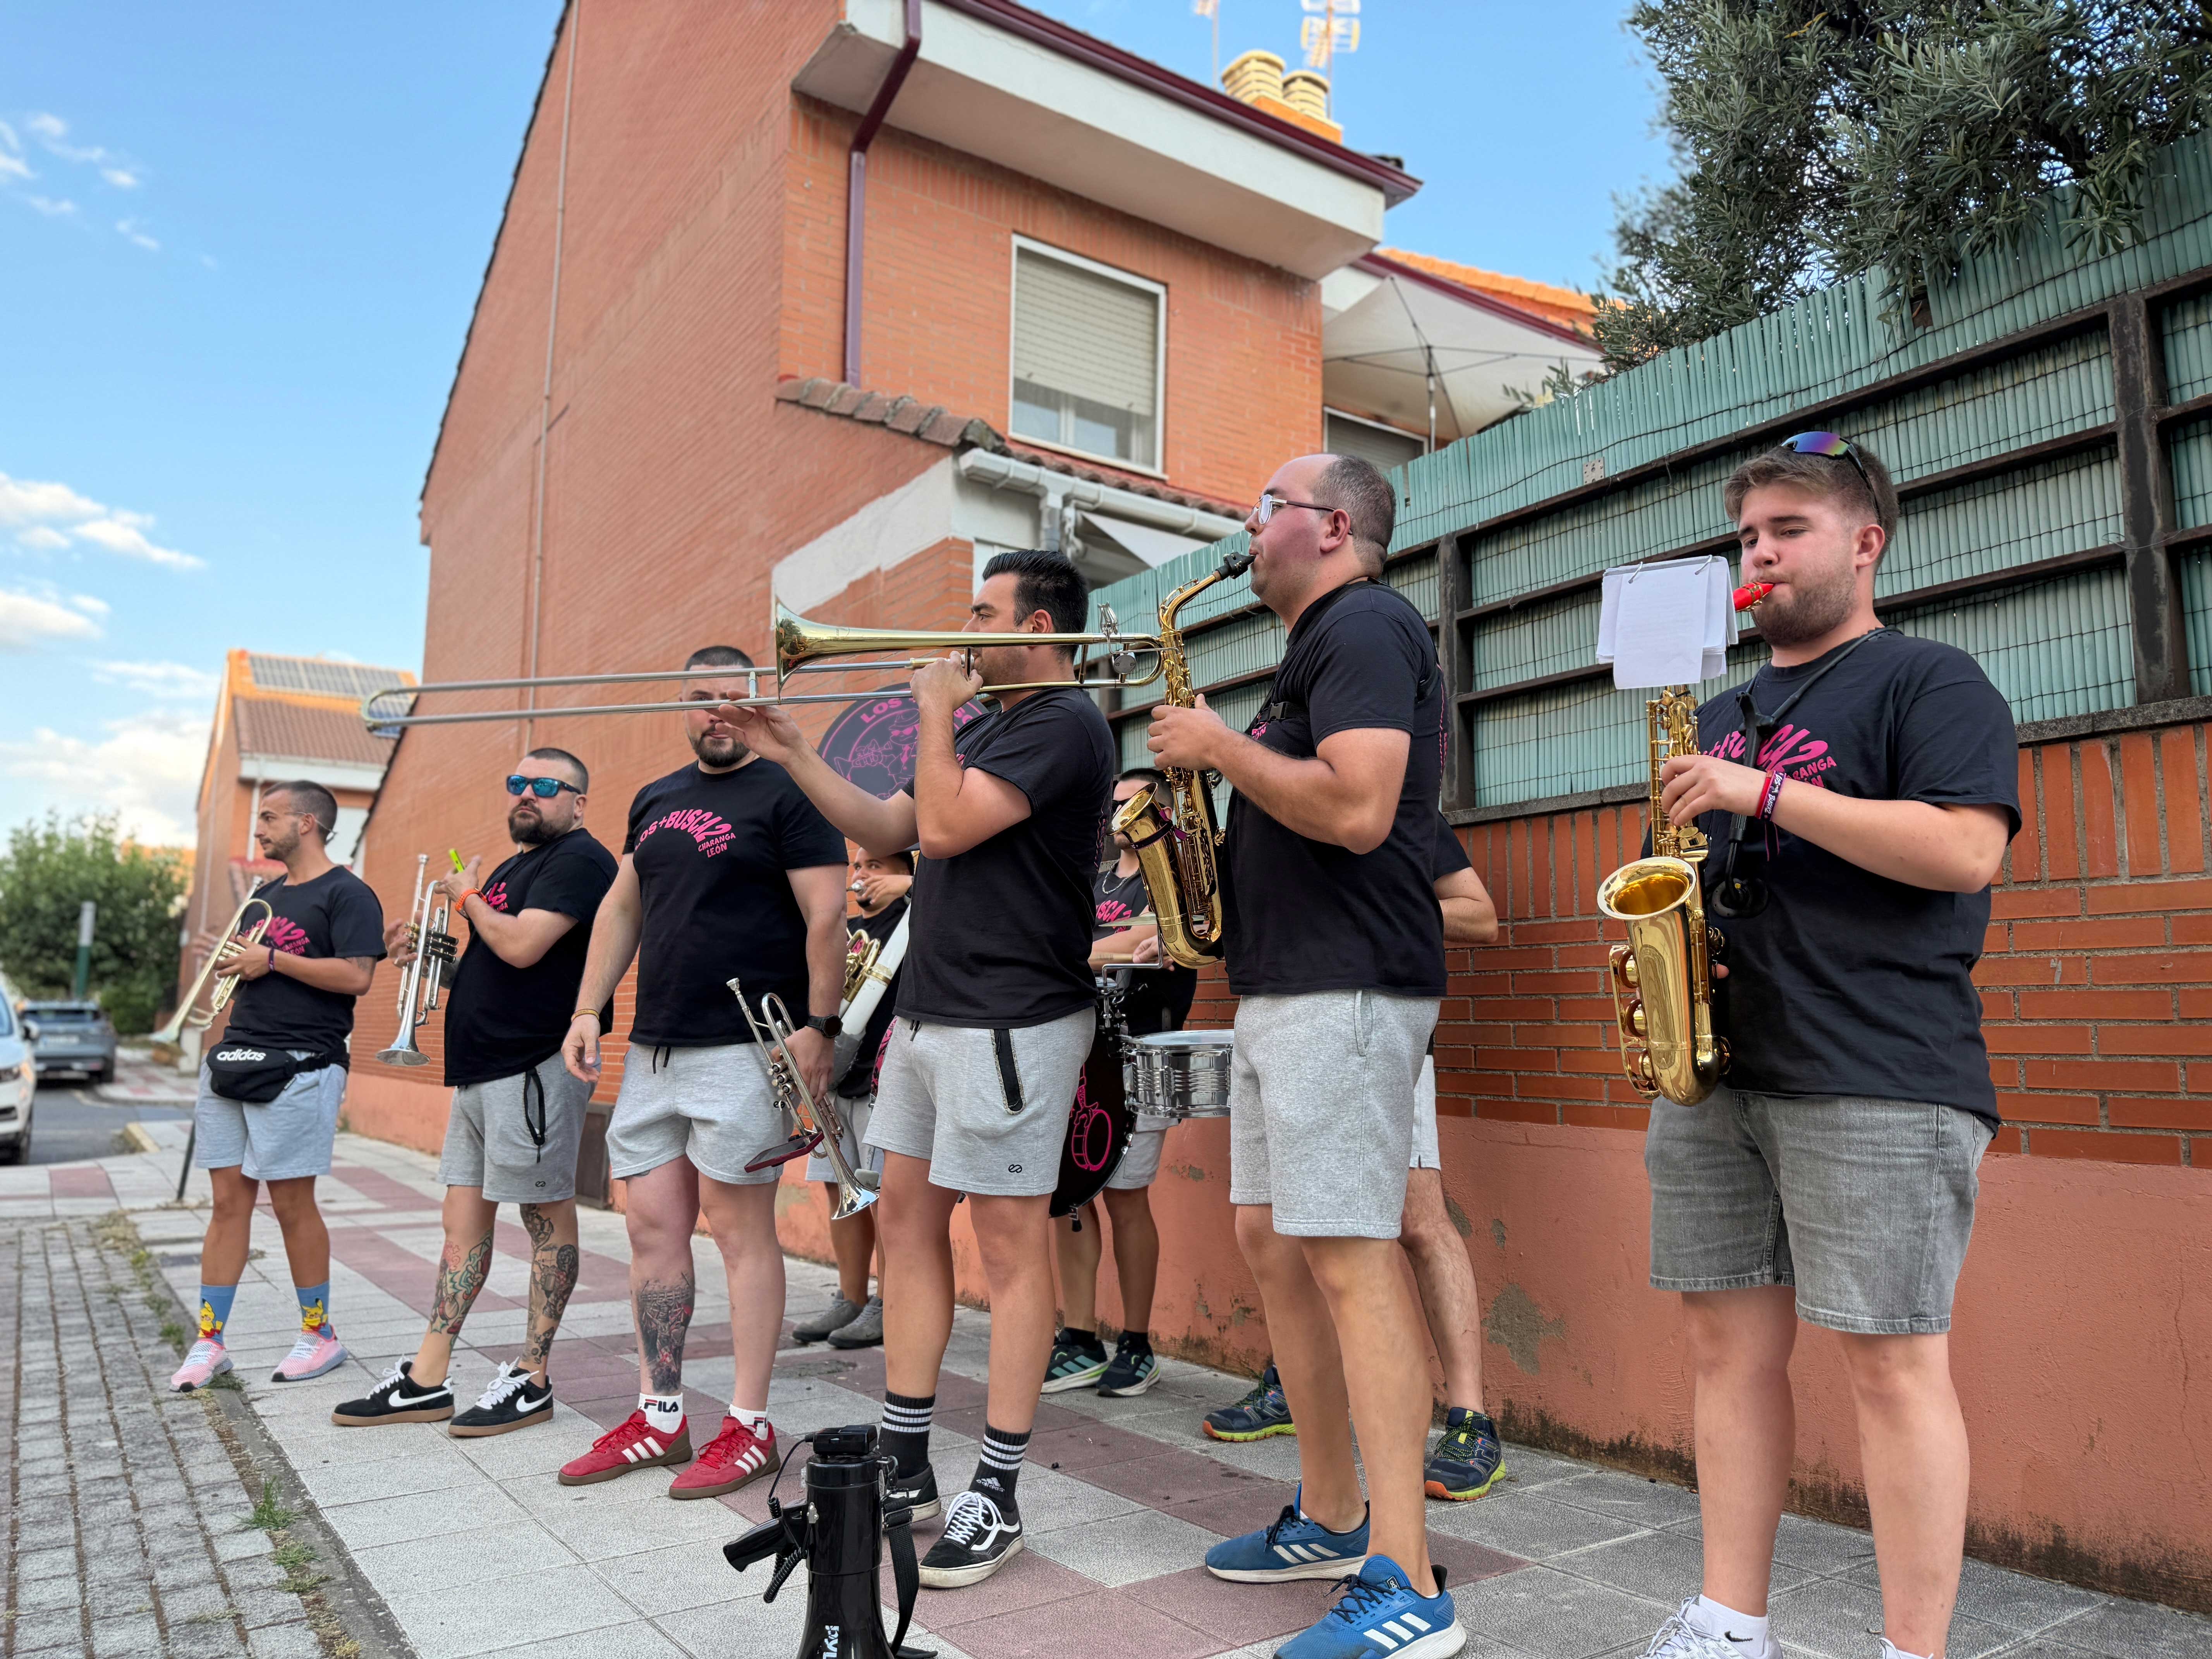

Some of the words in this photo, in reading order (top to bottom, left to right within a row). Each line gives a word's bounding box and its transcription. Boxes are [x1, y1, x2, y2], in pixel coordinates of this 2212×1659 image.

[860, 698, 902, 723] LOS
[698, 832, 736, 852] CHARANGA
[706, 842, 728, 858] LEÓN
[216, 1049, 266, 1061] adidas
[644, 1399, 679, 1413] FILA
[754, 1417, 767, 1428] FI
[976, 1479, 1005, 1492] adidas
[823, 1625, 840, 1659] PYL
